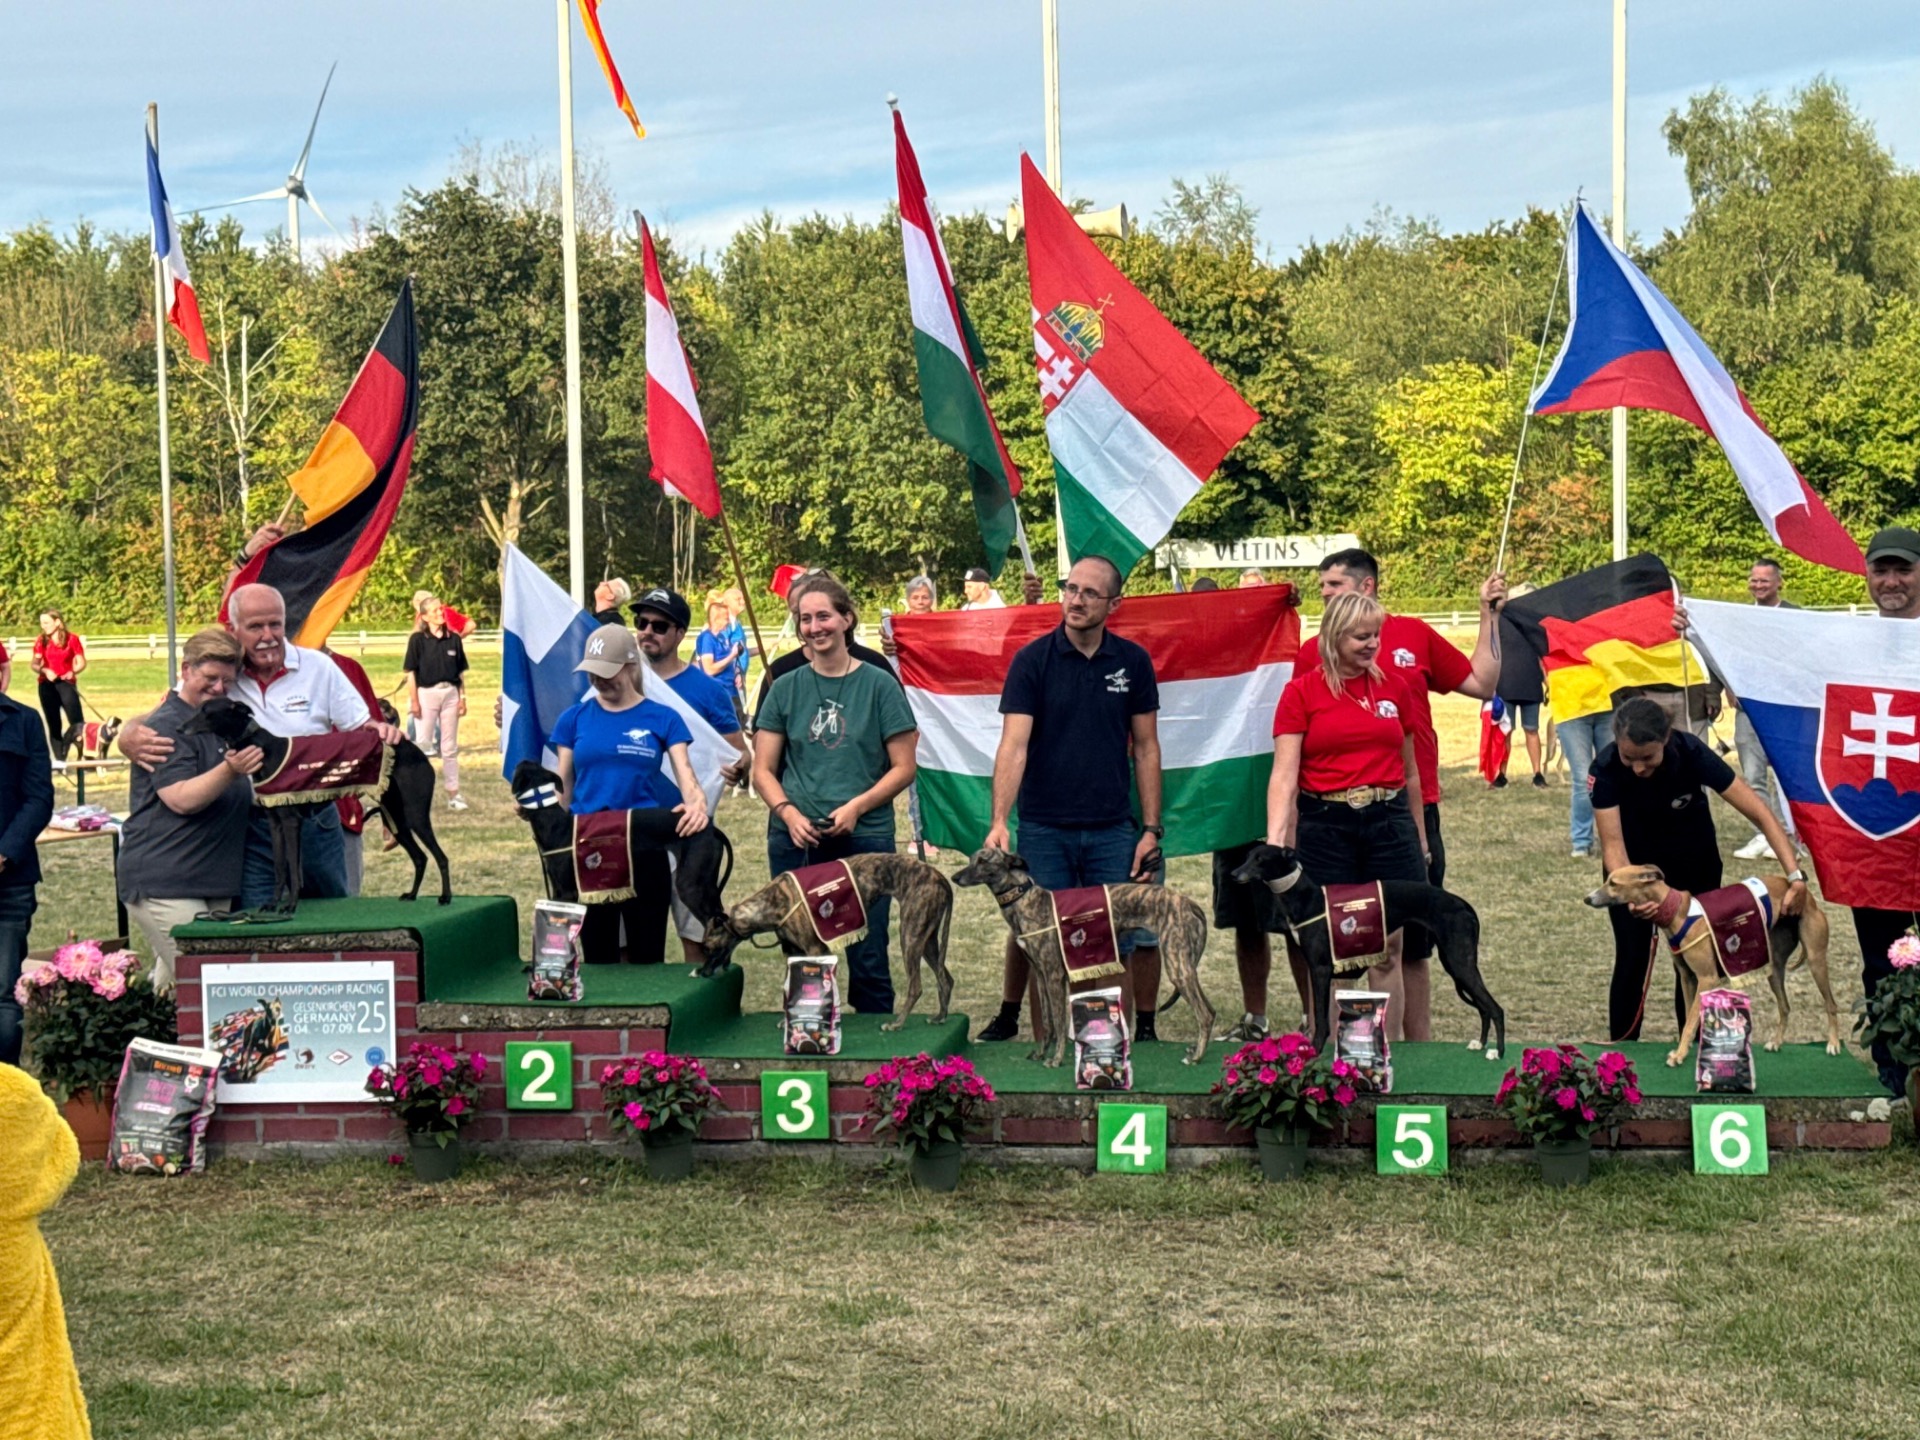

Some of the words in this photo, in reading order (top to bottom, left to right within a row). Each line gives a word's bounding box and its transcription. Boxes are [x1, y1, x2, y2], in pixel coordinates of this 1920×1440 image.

[1213, 541, 1300, 561] VELTINS
[589, 637, 605, 655] NY
[211, 986, 227, 998] FCI
[228, 985, 266, 998] WORLD
[268, 983, 344, 997] CHAMPIONSHIP
[346, 983, 385, 995] RACING
[293, 1002, 355, 1012] GELSENKIRCHEN
[294, 1012, 356, 1023] GERMANY
[357, 1001, 387, 1033] 25
[520, 1049, 557, 1102] 2
[776, 1078, 814, 1133] 3
[1111, 1112, 1152, 1166] 4
[1392, 1113, 1434, 1169] 5
[1709, 1110, 1751, 1168] 6
